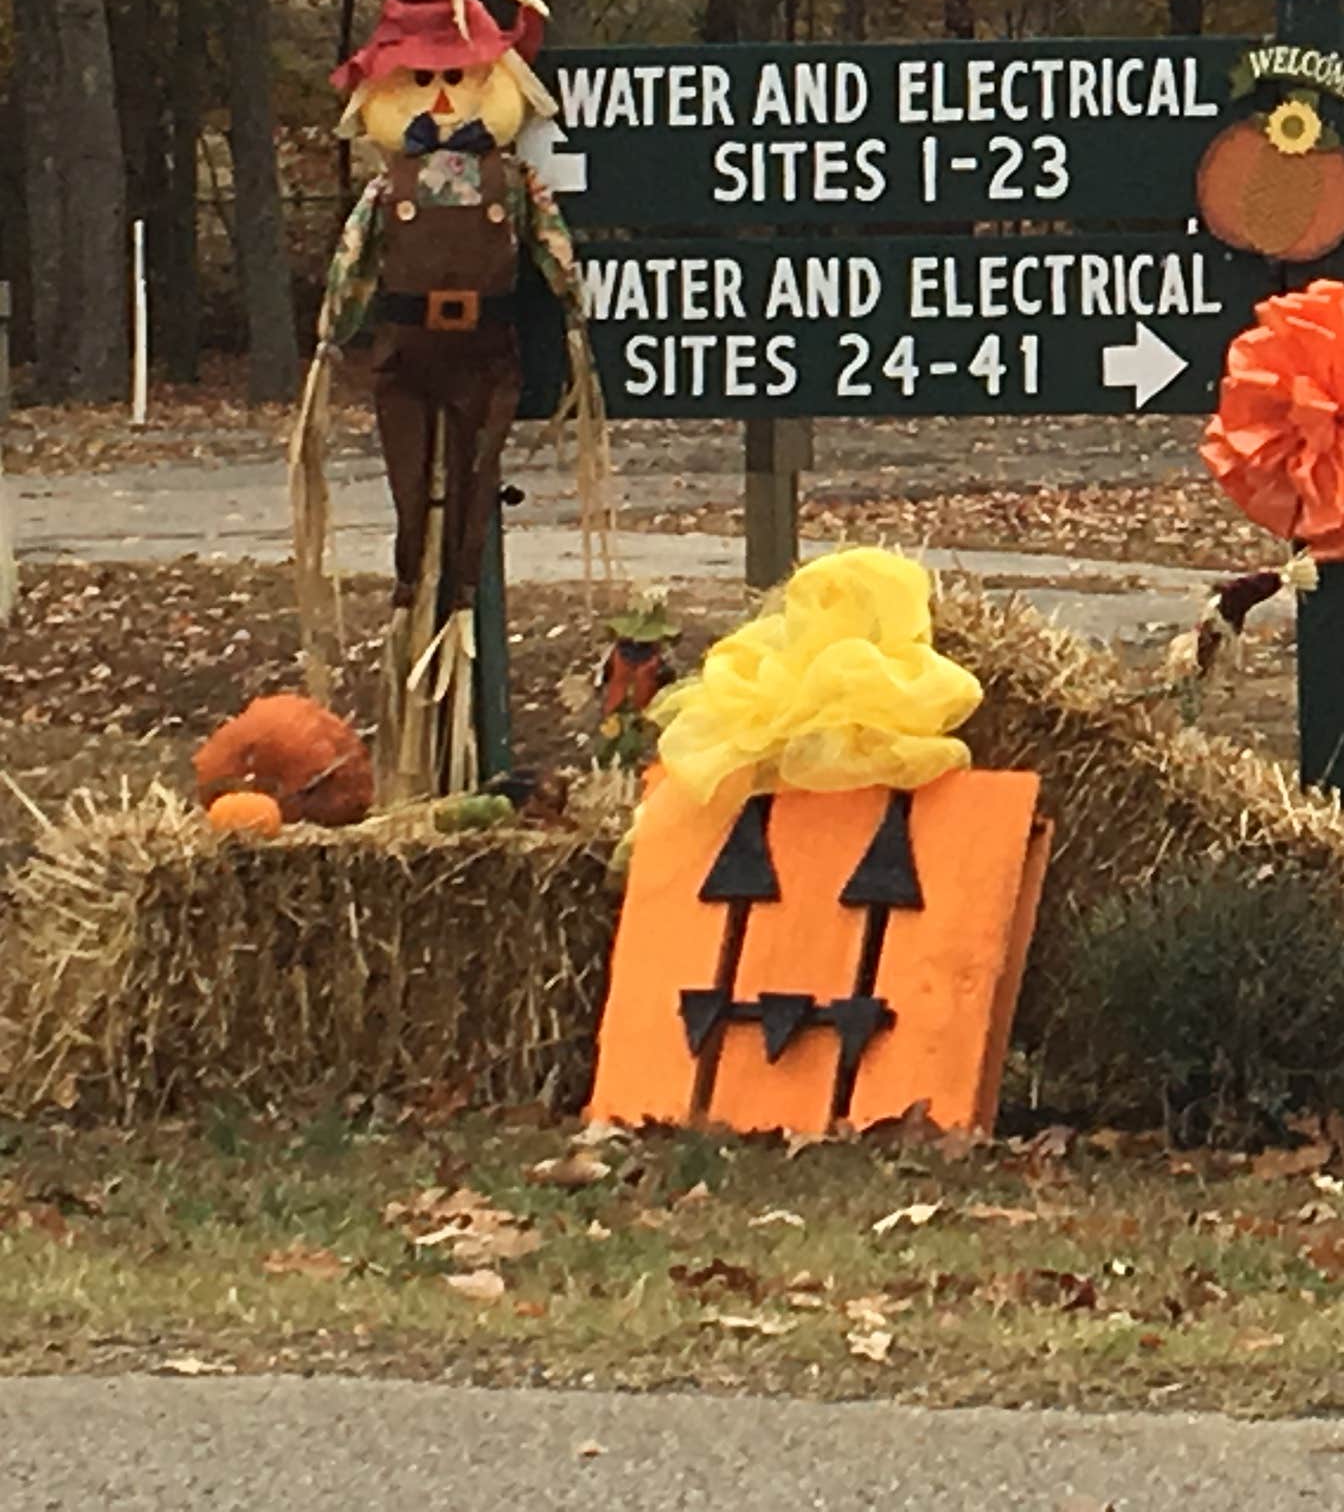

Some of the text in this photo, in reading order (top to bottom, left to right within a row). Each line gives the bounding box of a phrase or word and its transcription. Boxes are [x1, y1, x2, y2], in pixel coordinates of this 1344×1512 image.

[557, 57, 1219, 128] WATER AND ELECTRICAL
[713, 135, 1070, 202] SITES 1-23
[574, 252, 1223, 320] WATER AND ELECTRICAL
[624, 332, 1039, 397] SITES 24-41
